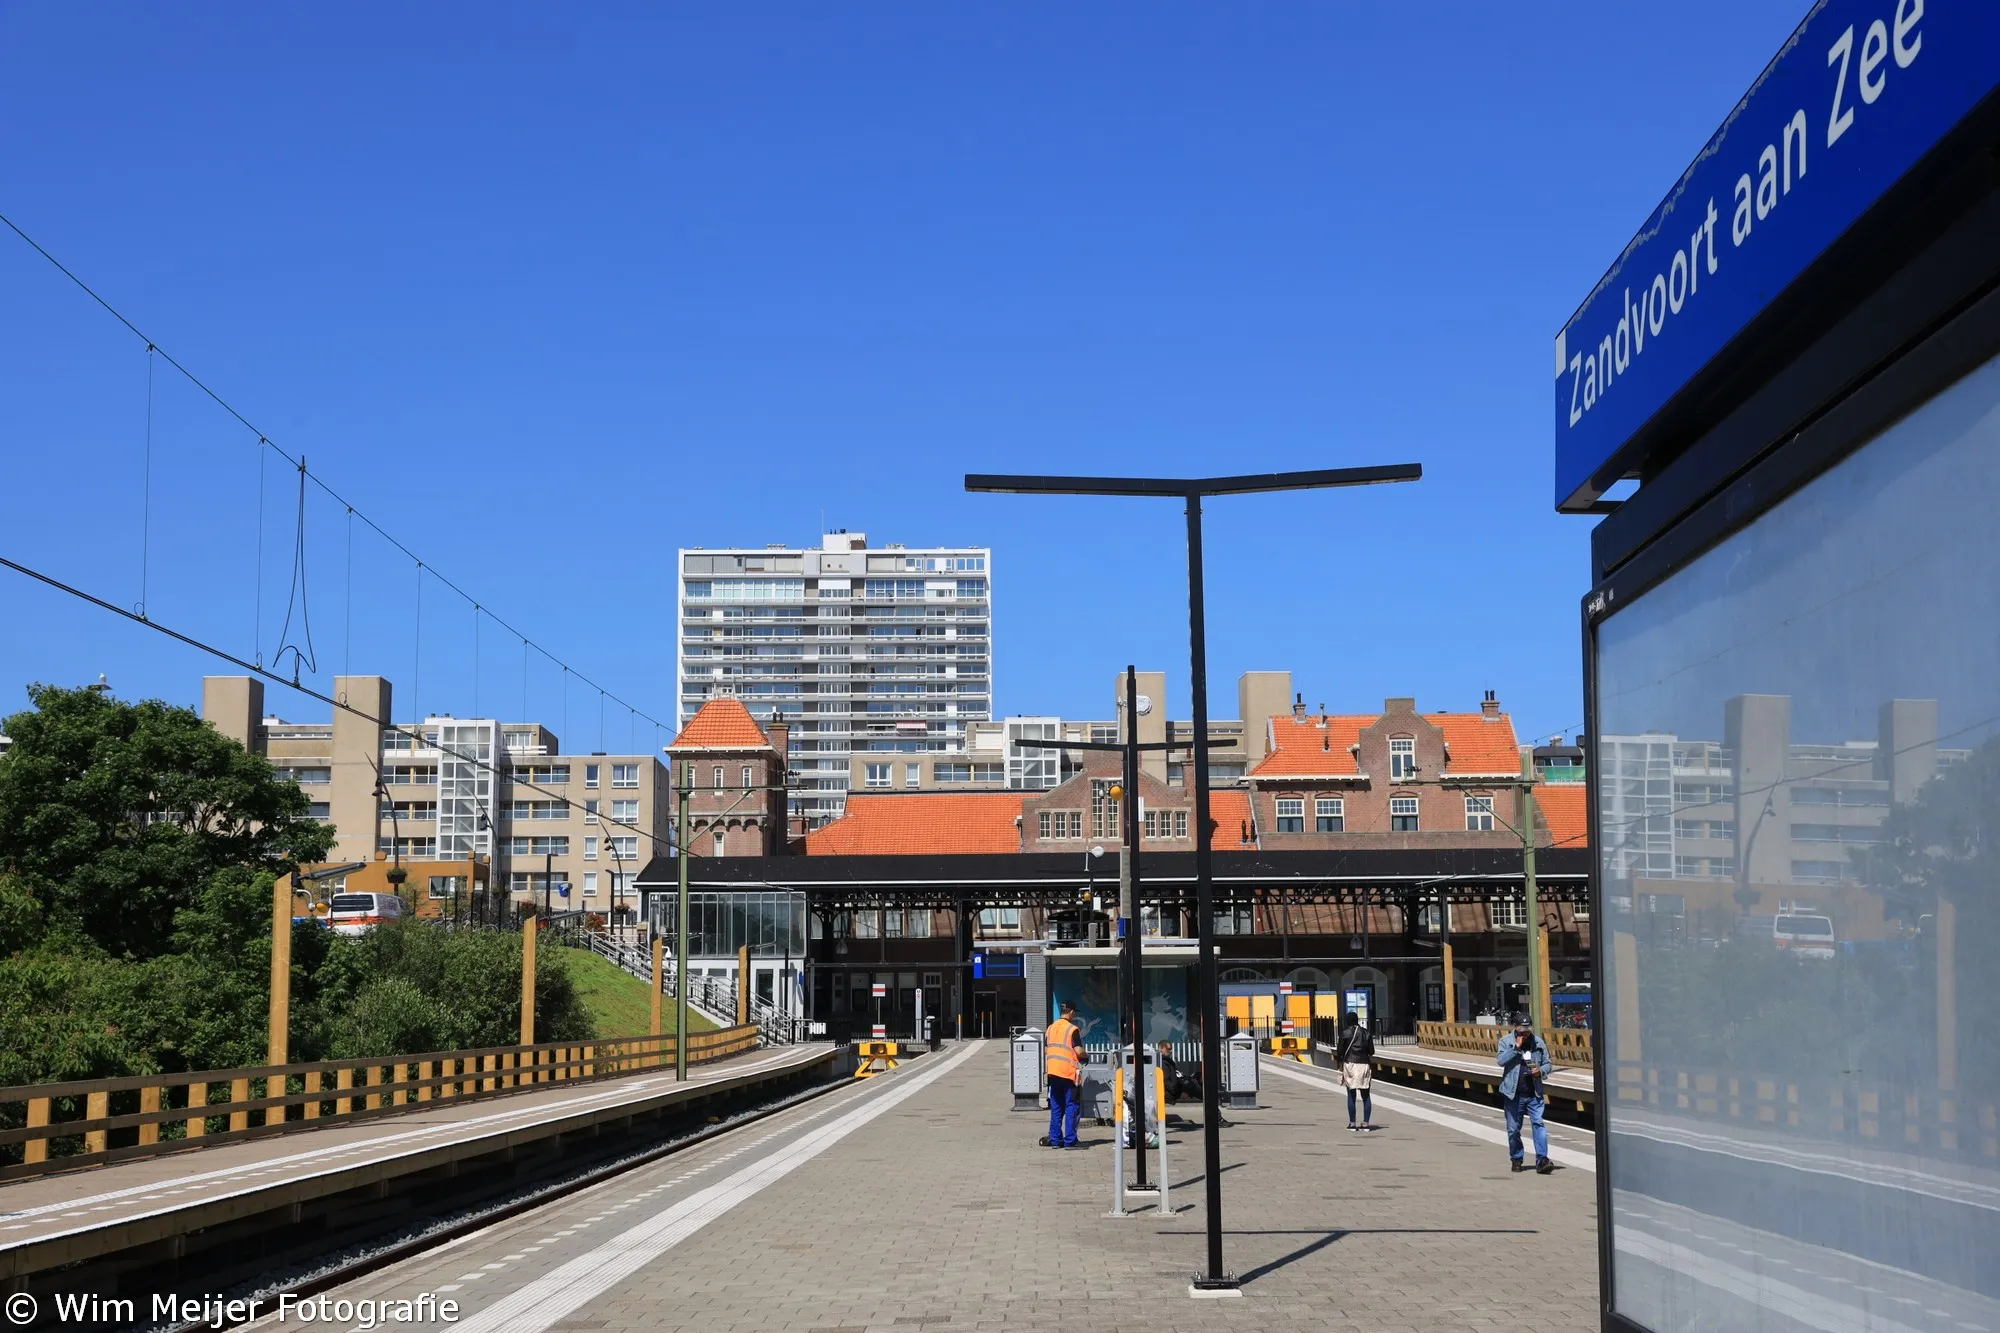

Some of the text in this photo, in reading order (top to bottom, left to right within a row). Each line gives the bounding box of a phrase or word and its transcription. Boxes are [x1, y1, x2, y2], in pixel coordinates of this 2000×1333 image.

[1569, 0, 1924, 428] Zandvoort aan Zee
